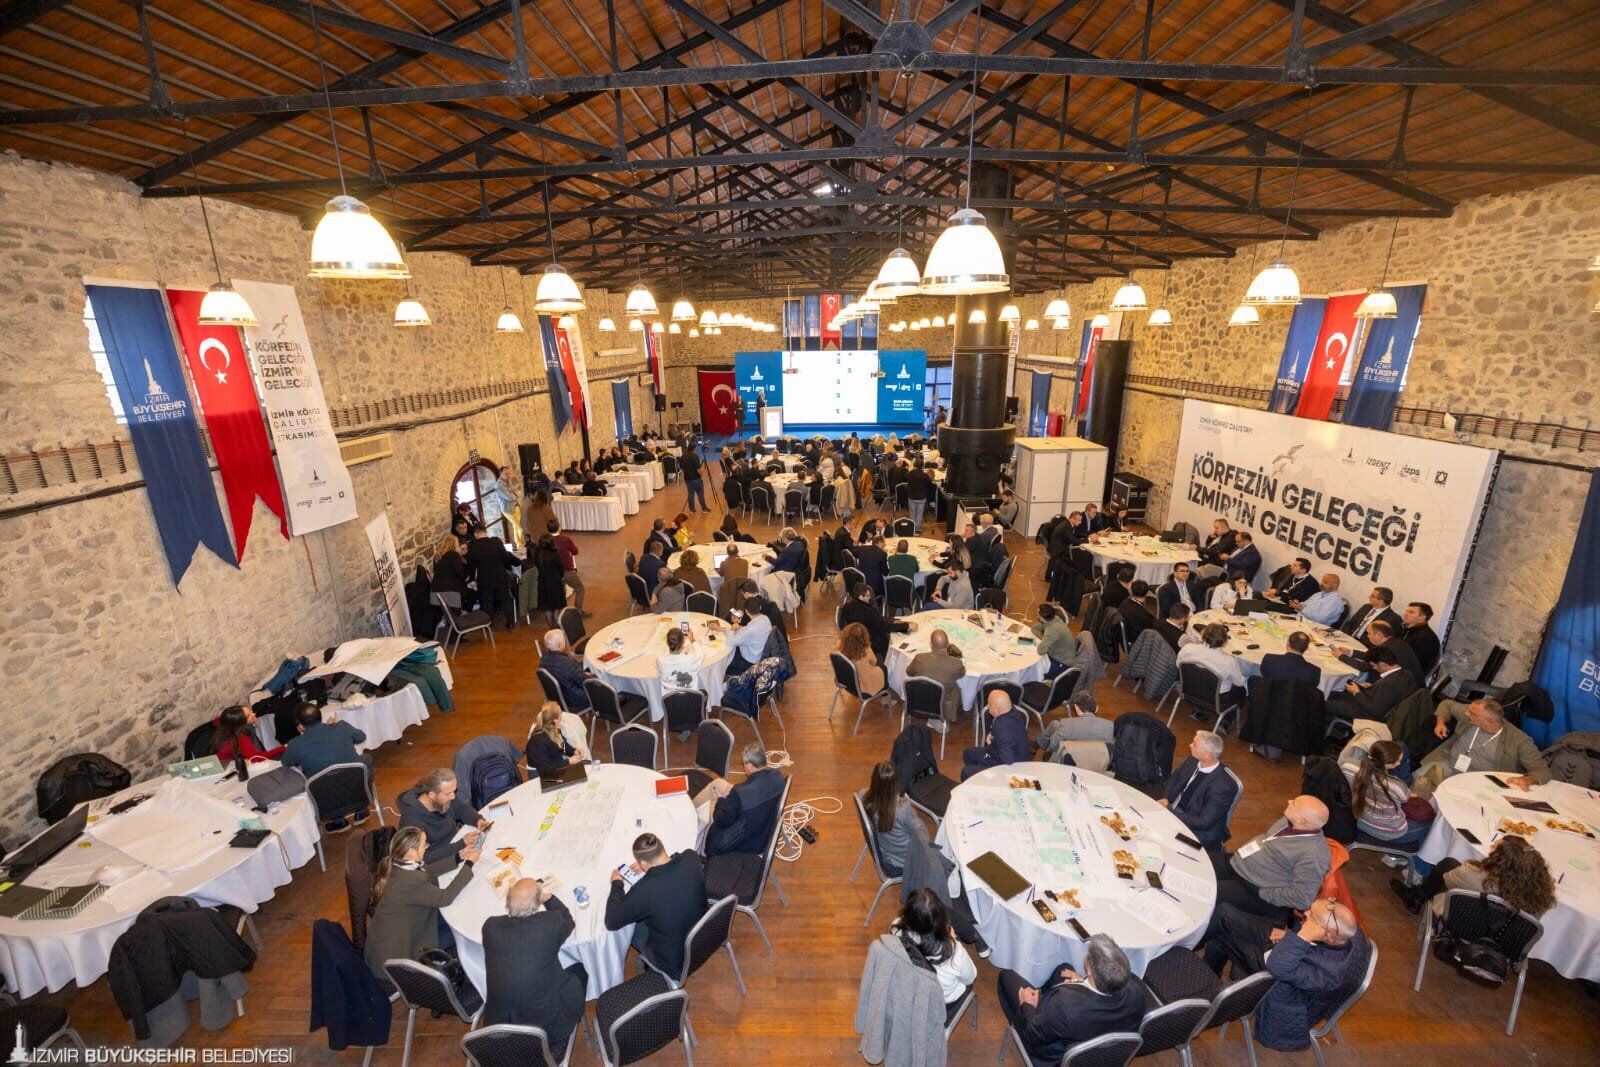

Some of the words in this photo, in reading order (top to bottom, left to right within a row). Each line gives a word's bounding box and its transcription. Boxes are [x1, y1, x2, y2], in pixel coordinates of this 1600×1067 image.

[1192, 451, 1278, 502] KÖRFEZİN
[1282, 483, 1421, 553] GELECEĞİ
[1260, 510, 1385, 583] GELECEĞİ
